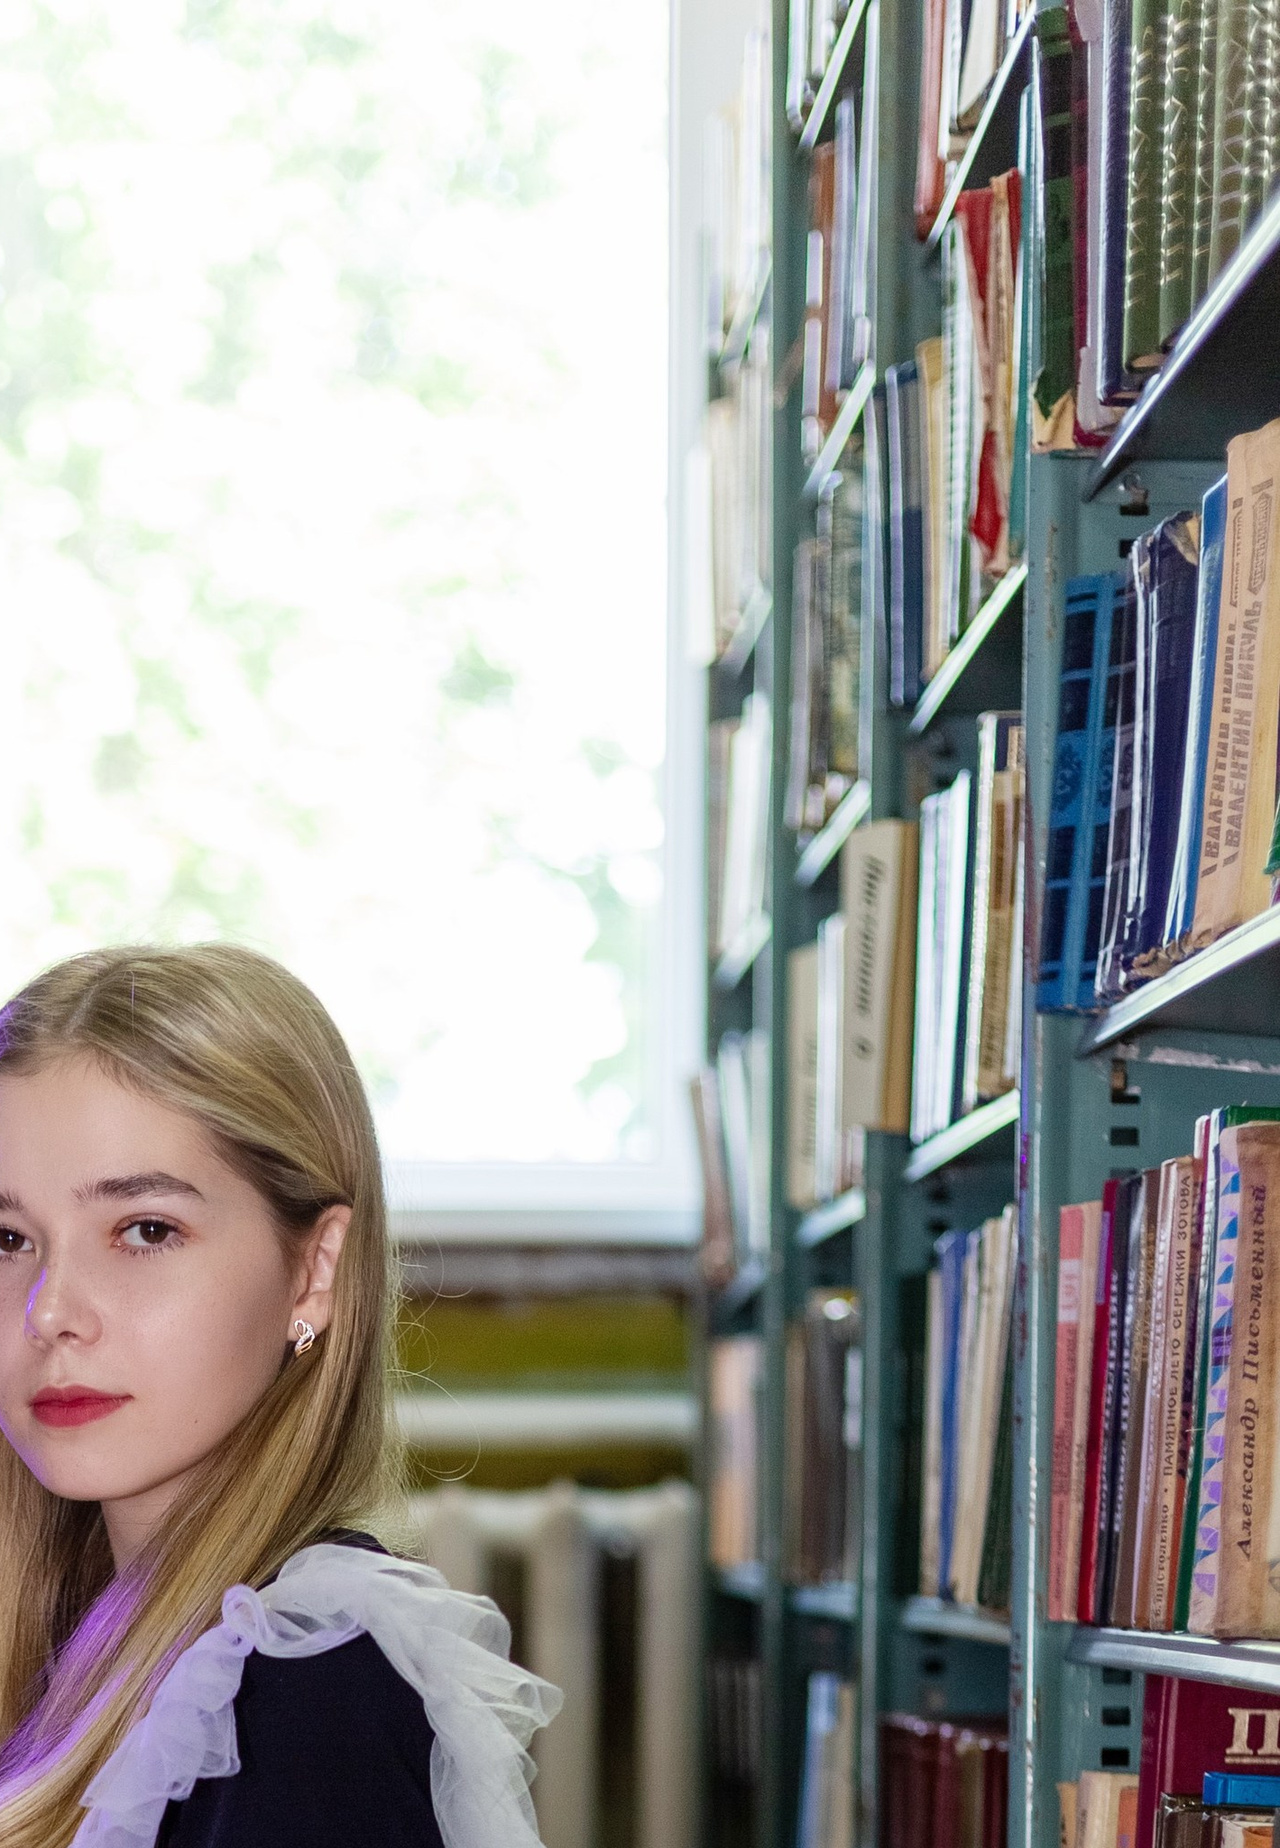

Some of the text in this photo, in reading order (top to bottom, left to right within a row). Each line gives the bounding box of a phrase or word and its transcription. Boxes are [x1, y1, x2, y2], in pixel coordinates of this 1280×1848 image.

[1234, 601, 1262, 700] ПИКУЛЬ
[1224, 709, 1252, 848] ВАЛЕНТИН
[1176, 1175, 1190, 1240] ЗОТОВА
[1172, 1250, 1186, 1329] СЕРЕЖКИ
[1170, 1338, 1180, 1381] ЛЕТО
[1236, 1184, 1267, 1562] Александр Письменный
[1162, 1387, 1179, 1477] ПАМЯТНОЕ
